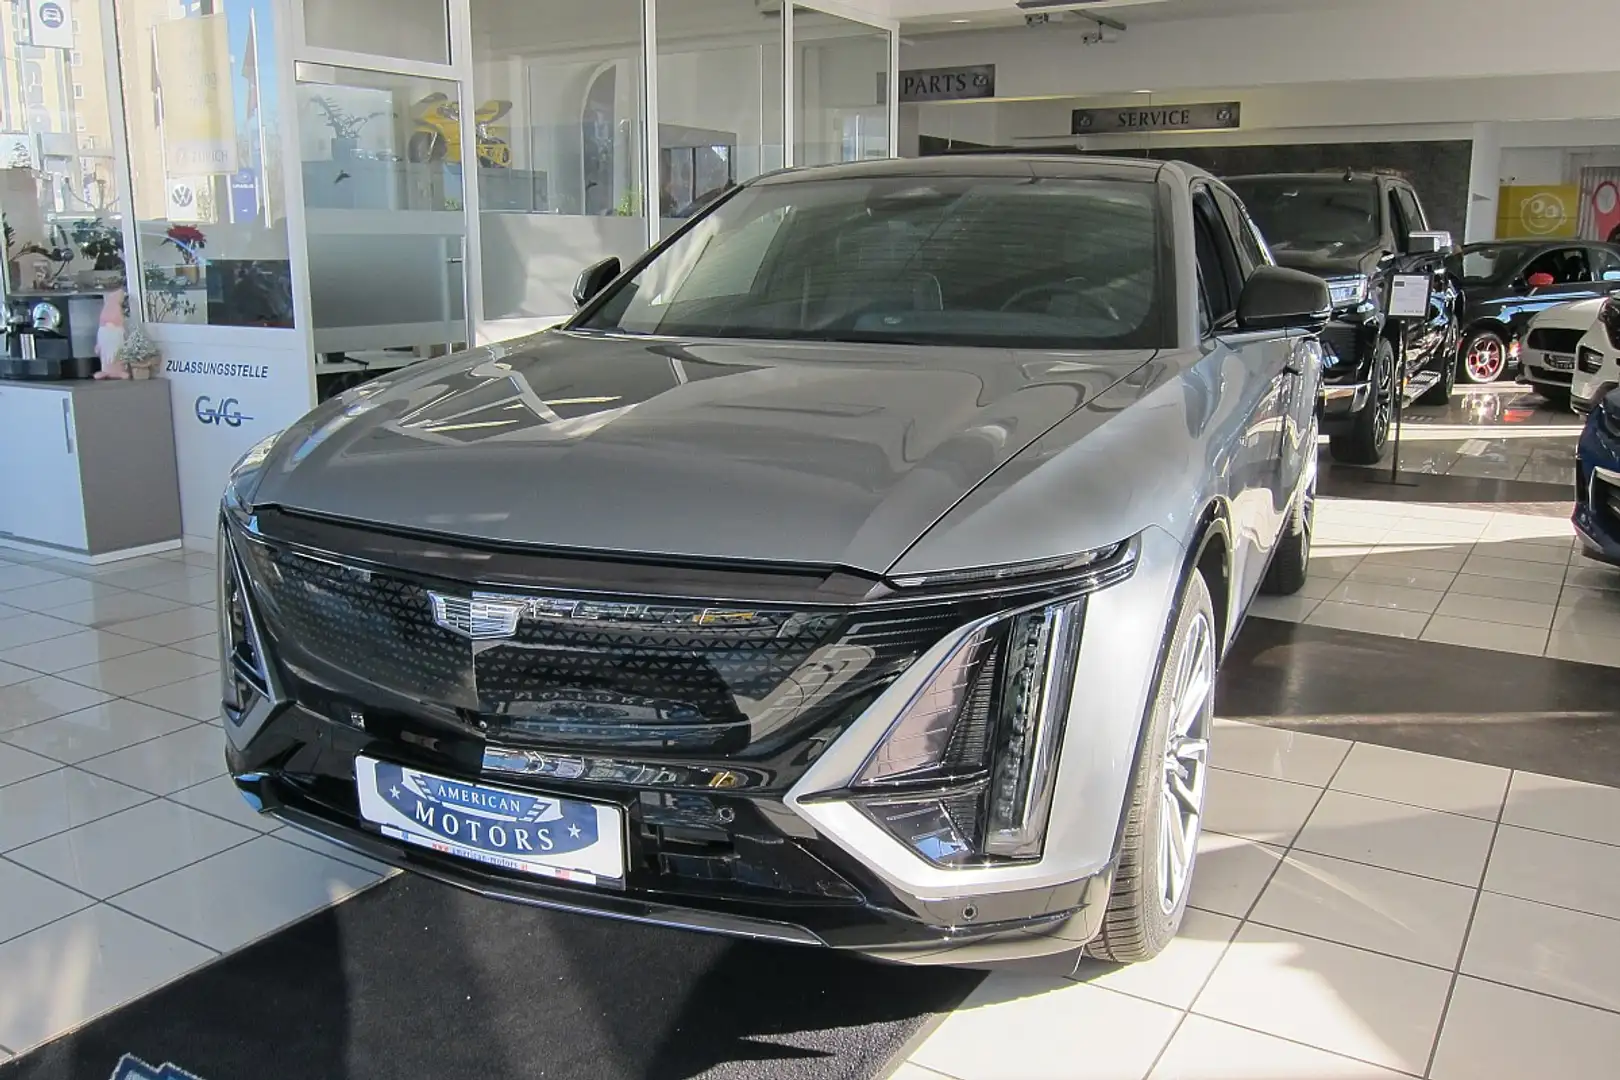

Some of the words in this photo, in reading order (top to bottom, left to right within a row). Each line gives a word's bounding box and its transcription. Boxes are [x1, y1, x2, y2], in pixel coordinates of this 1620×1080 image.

[904, 73, 967, 95] PARTS
[1117, 109, 1190, 128] SERVICE
[166, 360, 268, 378] ZULASSUNGSSTELLE
[437, 785, 521, 812] AMERICAN
[415, 801, 554, 850] MOTORS
